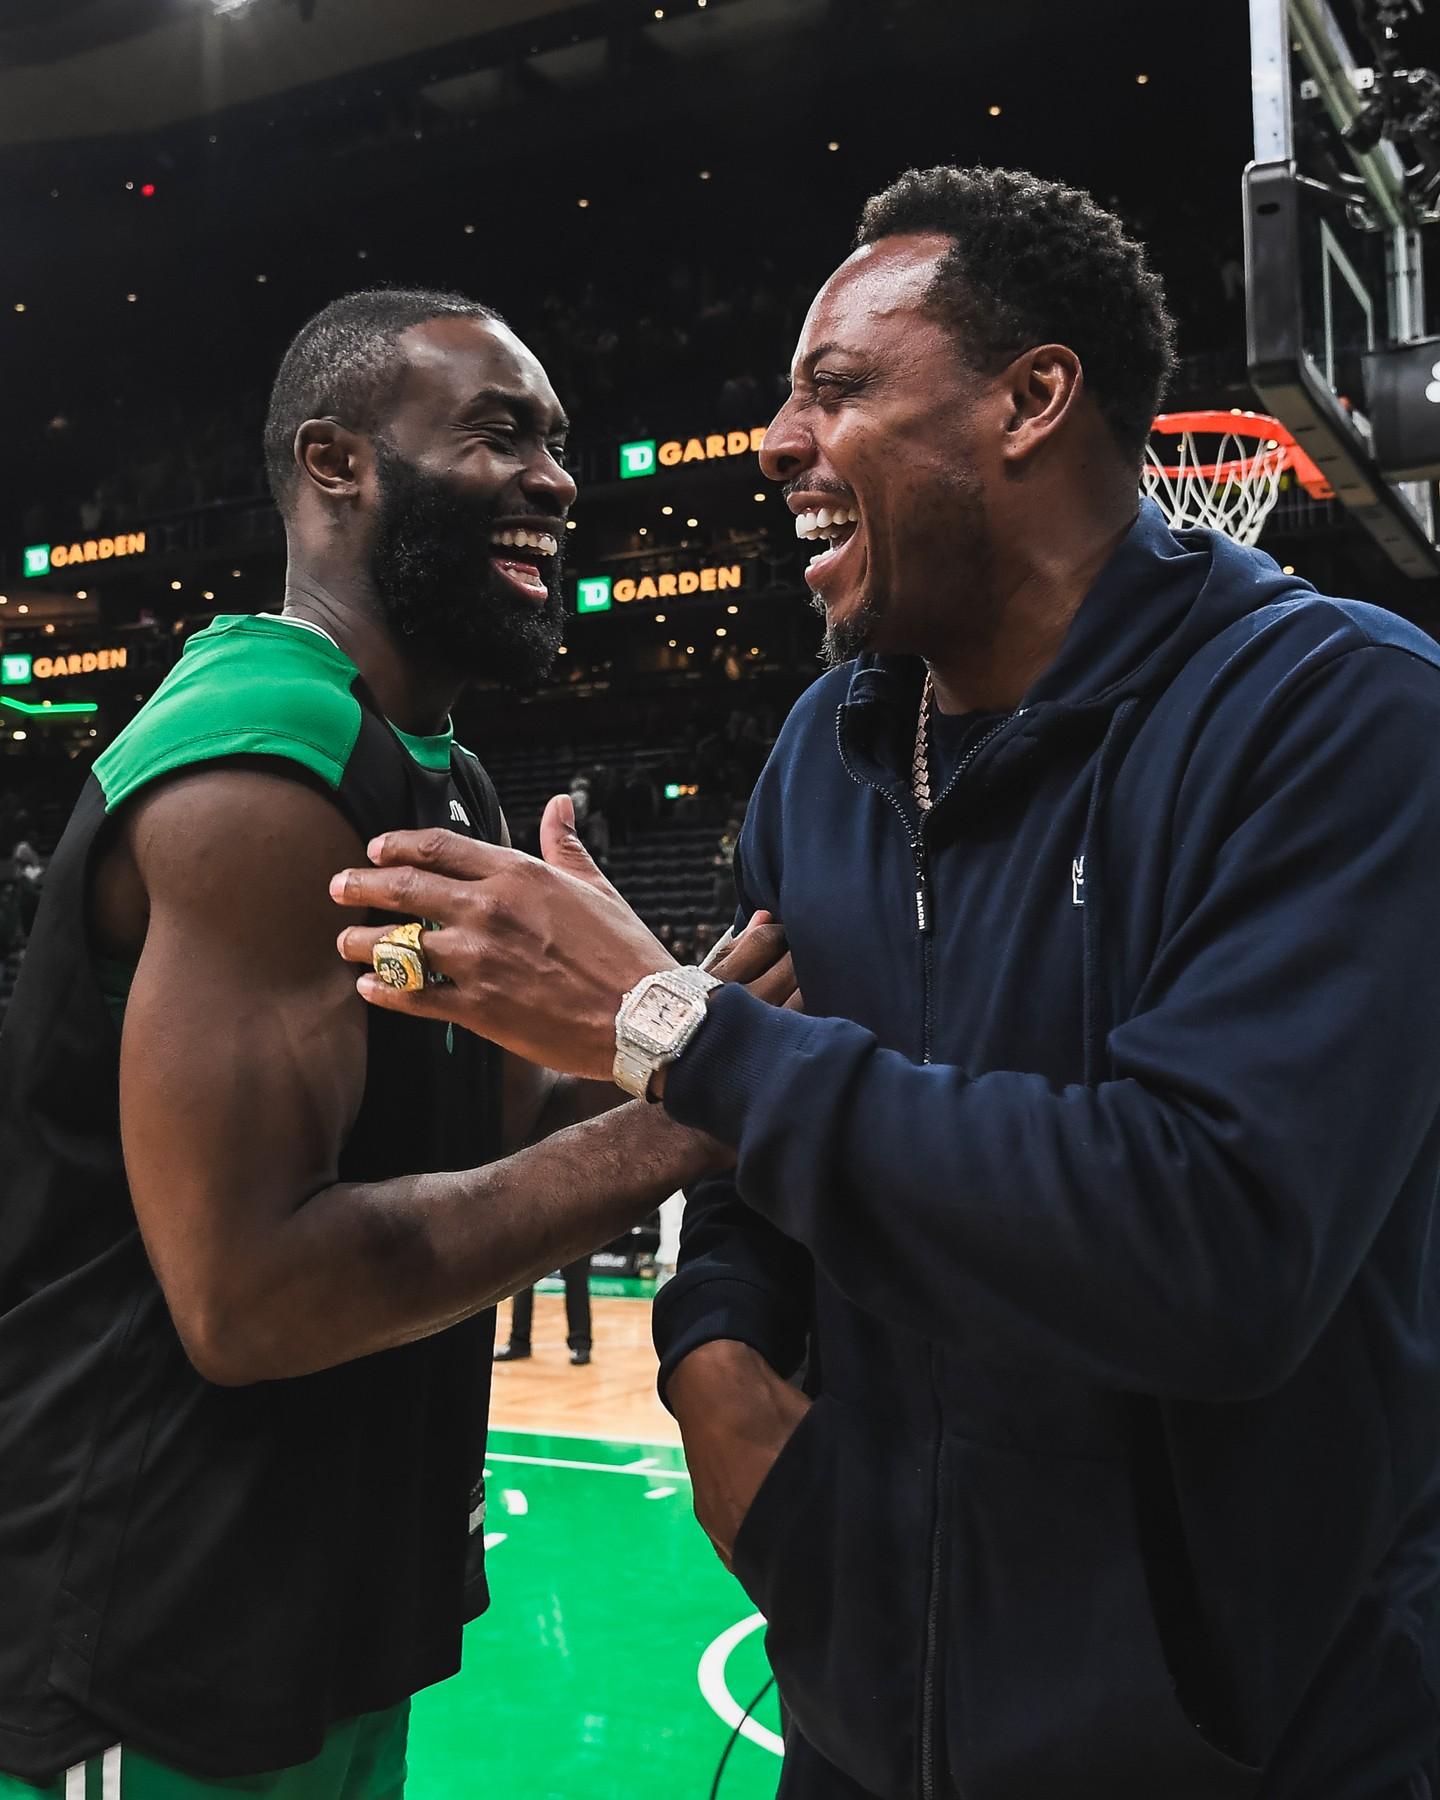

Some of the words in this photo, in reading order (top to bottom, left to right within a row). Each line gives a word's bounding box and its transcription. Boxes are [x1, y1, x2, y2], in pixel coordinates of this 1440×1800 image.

[622, 445, 654, 472] TD
[658, 427, 767, 466] GARDE
[25, 547, 49, 573] TD
[50, 531, 146, 568] GARDEN
[580, 582, 609, 607] TD
[613, 564, 741, 603] GARDEN
[32, 647, 127, 679] GARDEN
